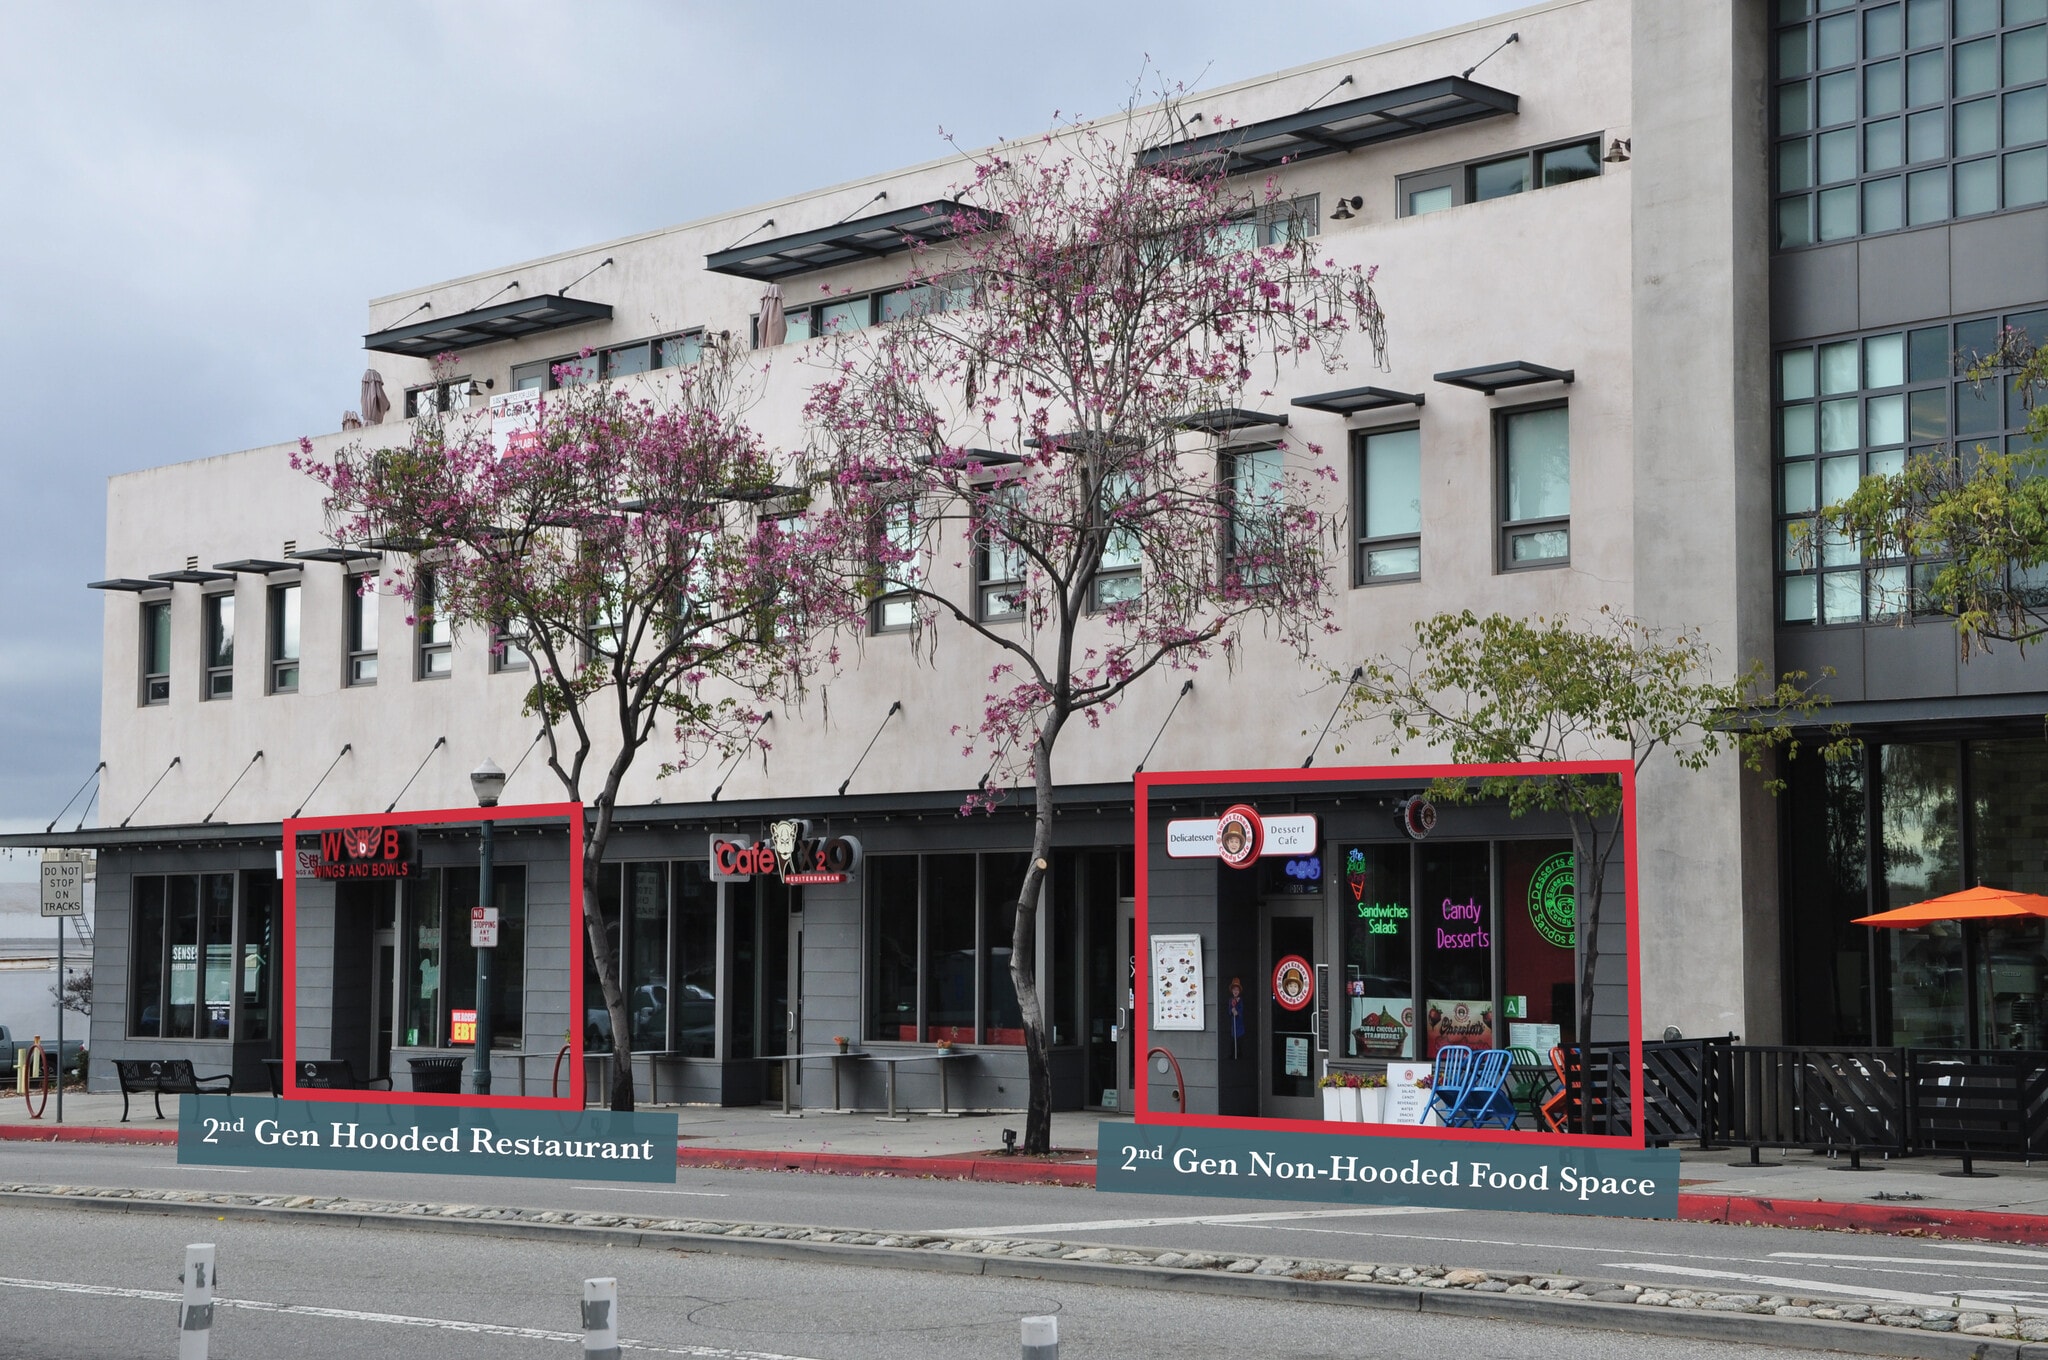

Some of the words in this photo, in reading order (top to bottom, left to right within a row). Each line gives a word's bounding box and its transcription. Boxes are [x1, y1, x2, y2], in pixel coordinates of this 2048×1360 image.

[1270, 825, 1305, 834] Dessert
[1170, 832, 1214, 842] Delicatessen
[1278, 836, 1298, 845] Cafe
[321, 831, 342, 862] W
[384, 829, 399, 860] B
[44, 867, 57, 876] DO
[61, 866, 79, 875] NOT
[314, 864, 345, 879] WINGS
[348, 863, 368, 878] AND
[372, 862, 408, 876] BOWLS
[50, 879, 74, 887] STOP
[1531, 858, 1565, 900] Desserts
[56, 891, 69, 899] ON
[44, 902, 80, 910] TRACKS
[1358, 902, 1408, 918] Sandwiches
[1442, 898, 1481, 924] Candy
[474, 910, 482, 918] NO
[1368, 918, 1397, 934] Salads
[1534, 913, 1566, 944] Sandos
[1437, 926, 1490, 948] Desserts
[1506, 1000, 1516, 1013] A
[454, 1023, 476, 1040] EBT
[1364, 1032, 1400, 1040] STRAWBERRIES
